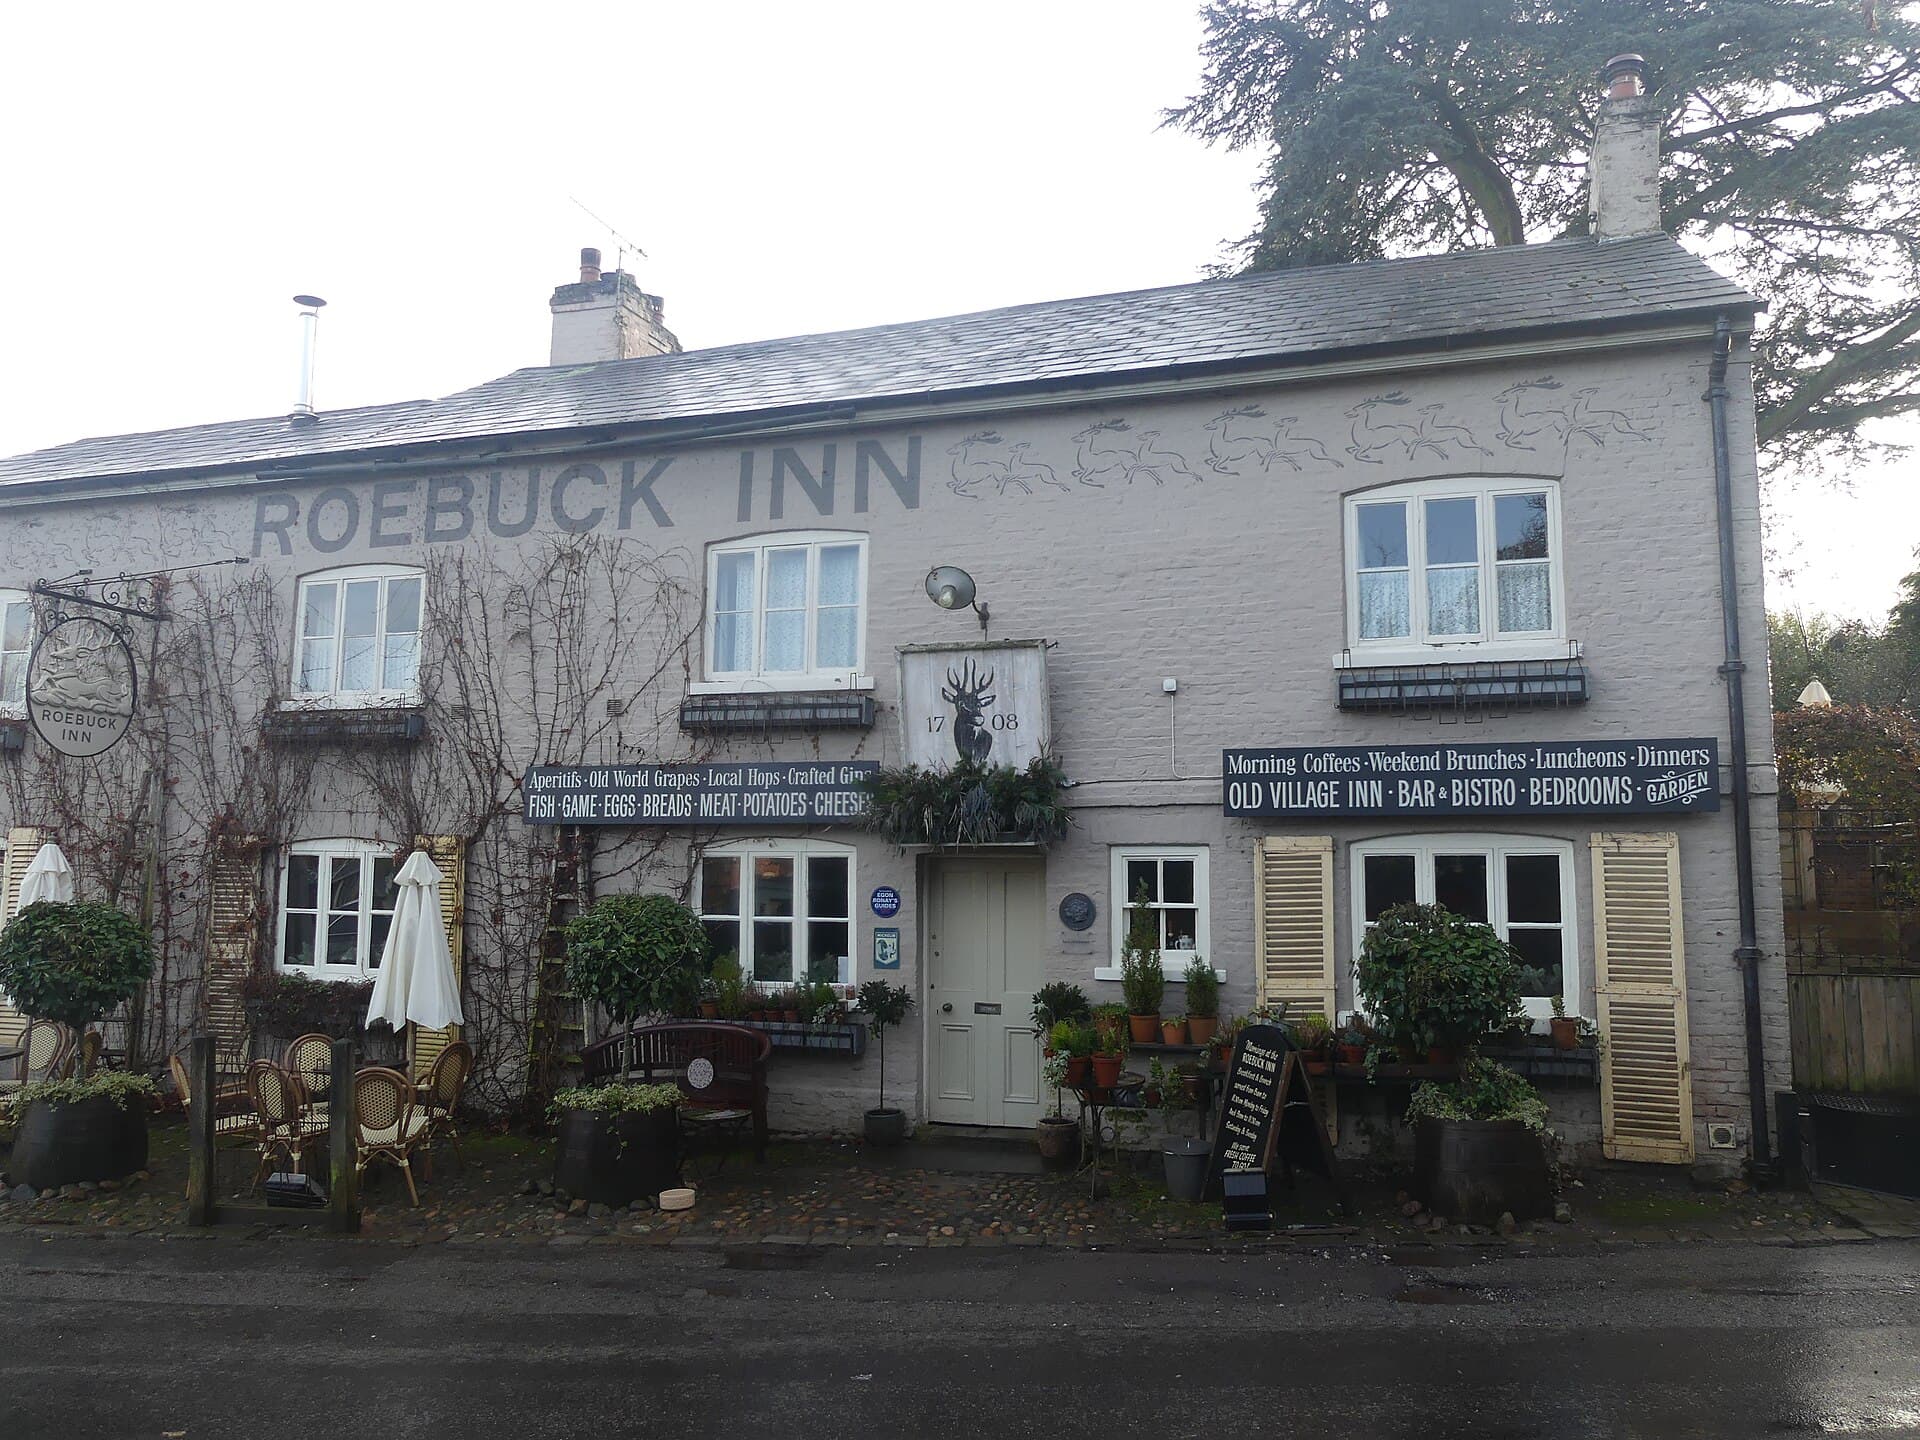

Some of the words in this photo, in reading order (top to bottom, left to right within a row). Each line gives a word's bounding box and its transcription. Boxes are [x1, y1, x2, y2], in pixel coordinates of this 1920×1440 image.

[251, 456, 676, 558] ROEBUCK
[736, 435, 923, 522] INN
[42, 709, 117, 730] ROEBUCK
[927, 716, 945, 733] 17
[992, 713, 1019, 731] 08
[62, 728, 92, 744] INN
[1228, 755, 1297, 776] Morning
[1303, 753, 1361, 773] Coffees
[1368, 751, 1441, 773] Weekend
[1446, 750, 1527, 771] Brunches
[1535, 748, 1627, 769] Luncheons
[1636, 745, 1710, 767] Dinners
[528, 771, 582, 792] Aperitifs
[589, 770, 609, 788] Old
[613, 770, 649, 788] World
[654, 769, 700, 791] Grapes
[708, 768, 742, 787] Local
[748, 768, 780, 790] Hops
[788, 766, 835, 785] Crafted
[1229, 782, 1263, 810] OLD
[1269, 780, 1340, 809] VILLAGE
[1348, 780, 1383, 808] INN
[1398, 779, 1435, 808] BAR
[1438, 786, 1447, 799] &
[1451, 778, 1516, 807] BISTRO
[1529, 776, 1633, 806] BEDROOMS
[1646, 771, 1708, 803] GARDEN
[528, 794, 555, 818] FISH
[562, 794, 597, 817] GAME
[604, 794, 636, 818] EGGS
[643, 793, 692, 817] BREADS
[700, 793, 738, 816] MEAT
[743, 792, 807, 817] POTATOES
[1241, 1052, 1266, 1069] ROEBUCK
[1264, 1060, 1277, 1073] INN
[1223, 1149, 1239, 1160] FRESH
[1238, 1151, 1257, 1163] COFFEE
